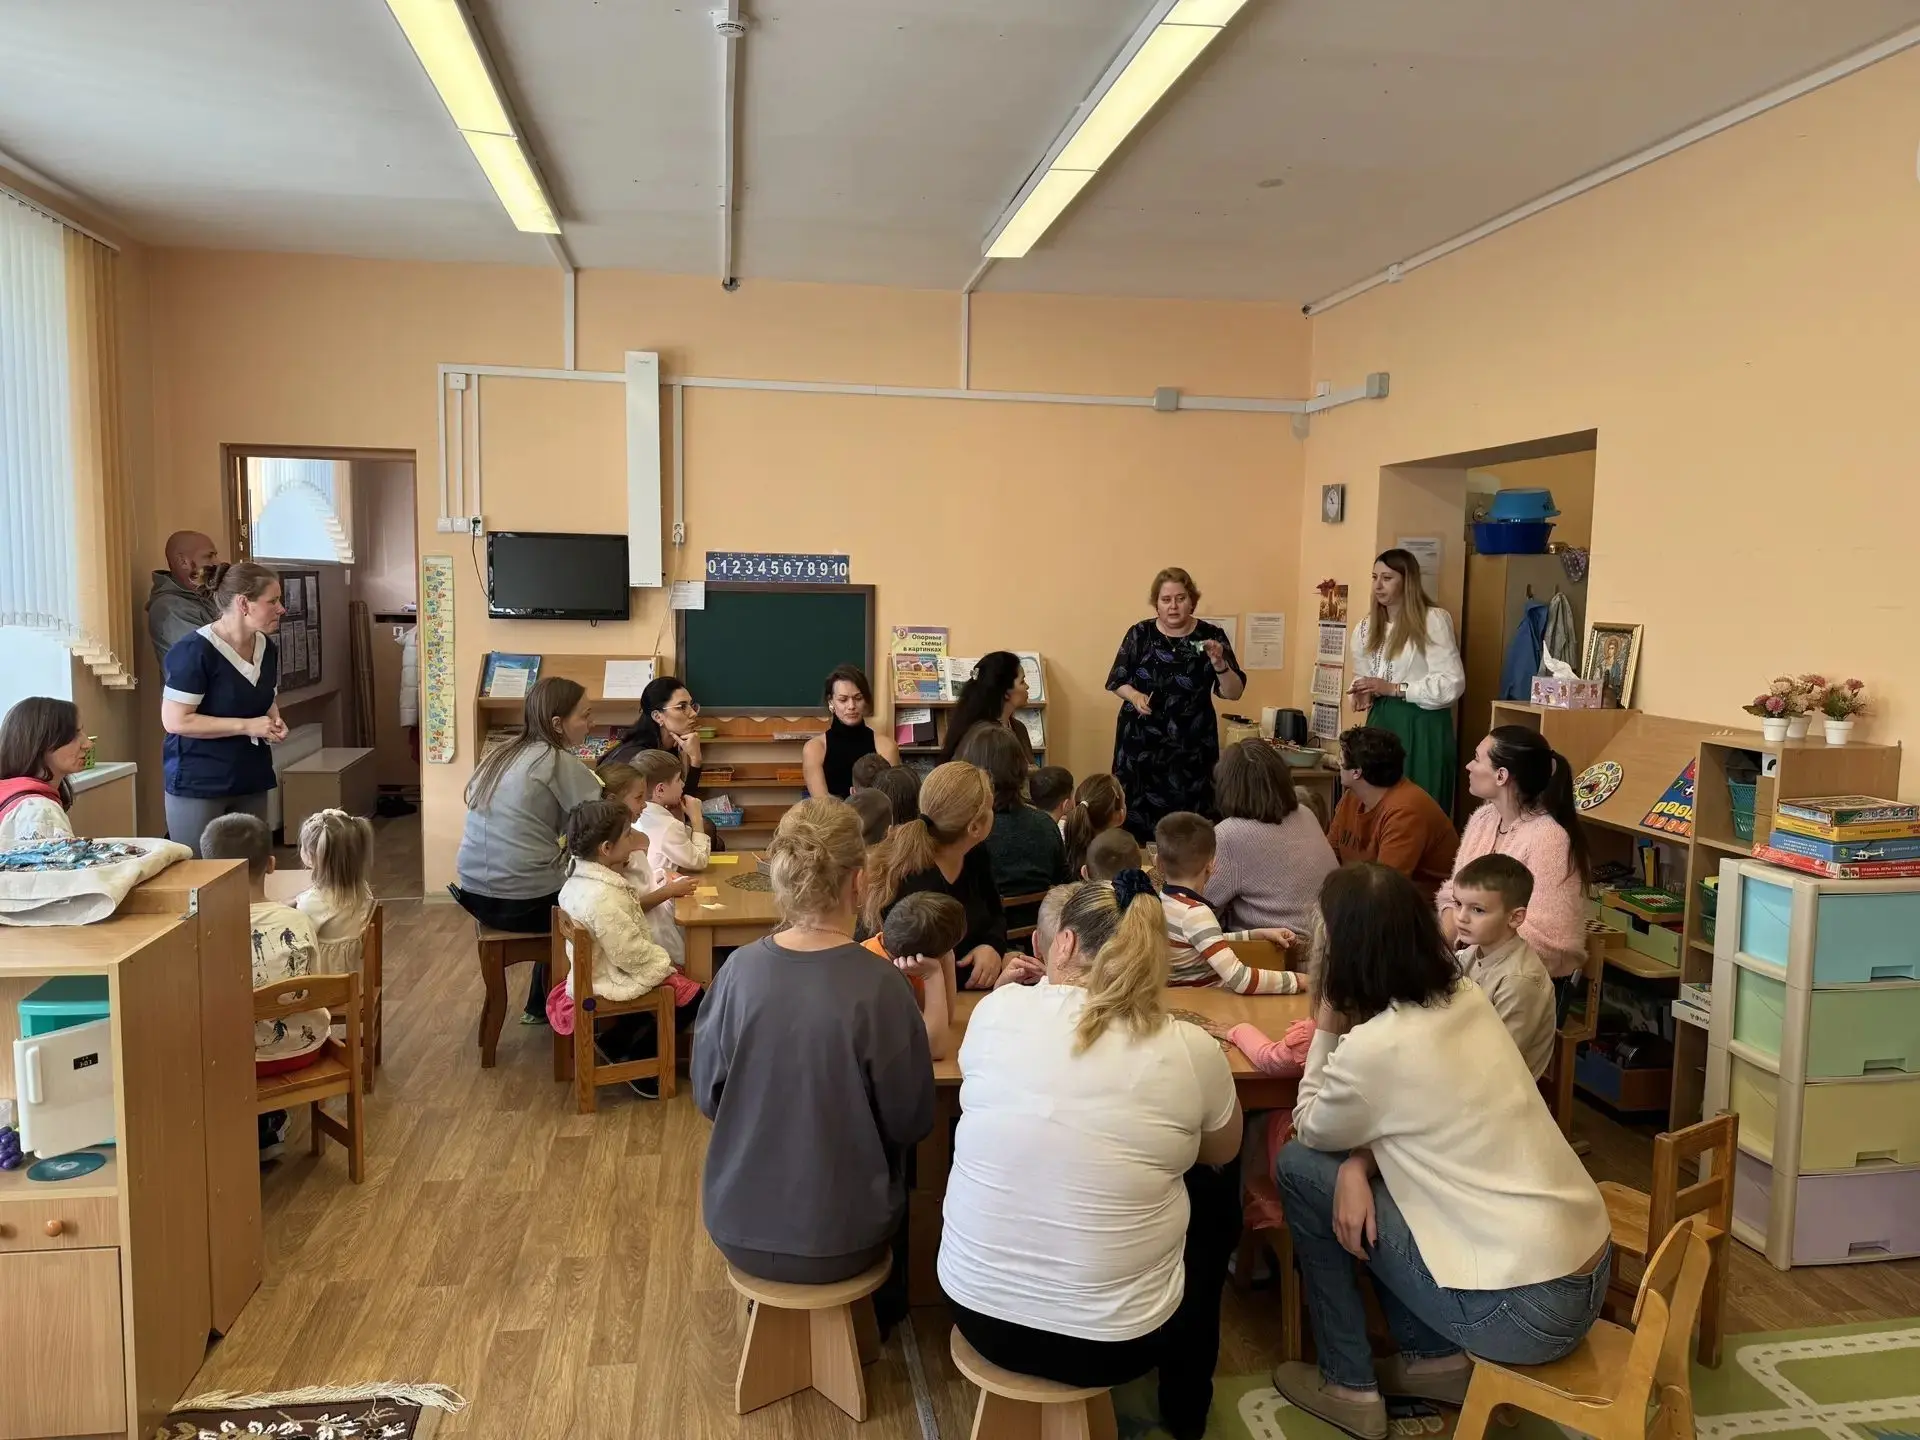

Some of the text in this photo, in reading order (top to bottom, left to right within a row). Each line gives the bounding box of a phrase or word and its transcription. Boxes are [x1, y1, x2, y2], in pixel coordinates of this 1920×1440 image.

[708, 560, 847, 576] 0 1 2 3 4 5 6 7 8 9 10
